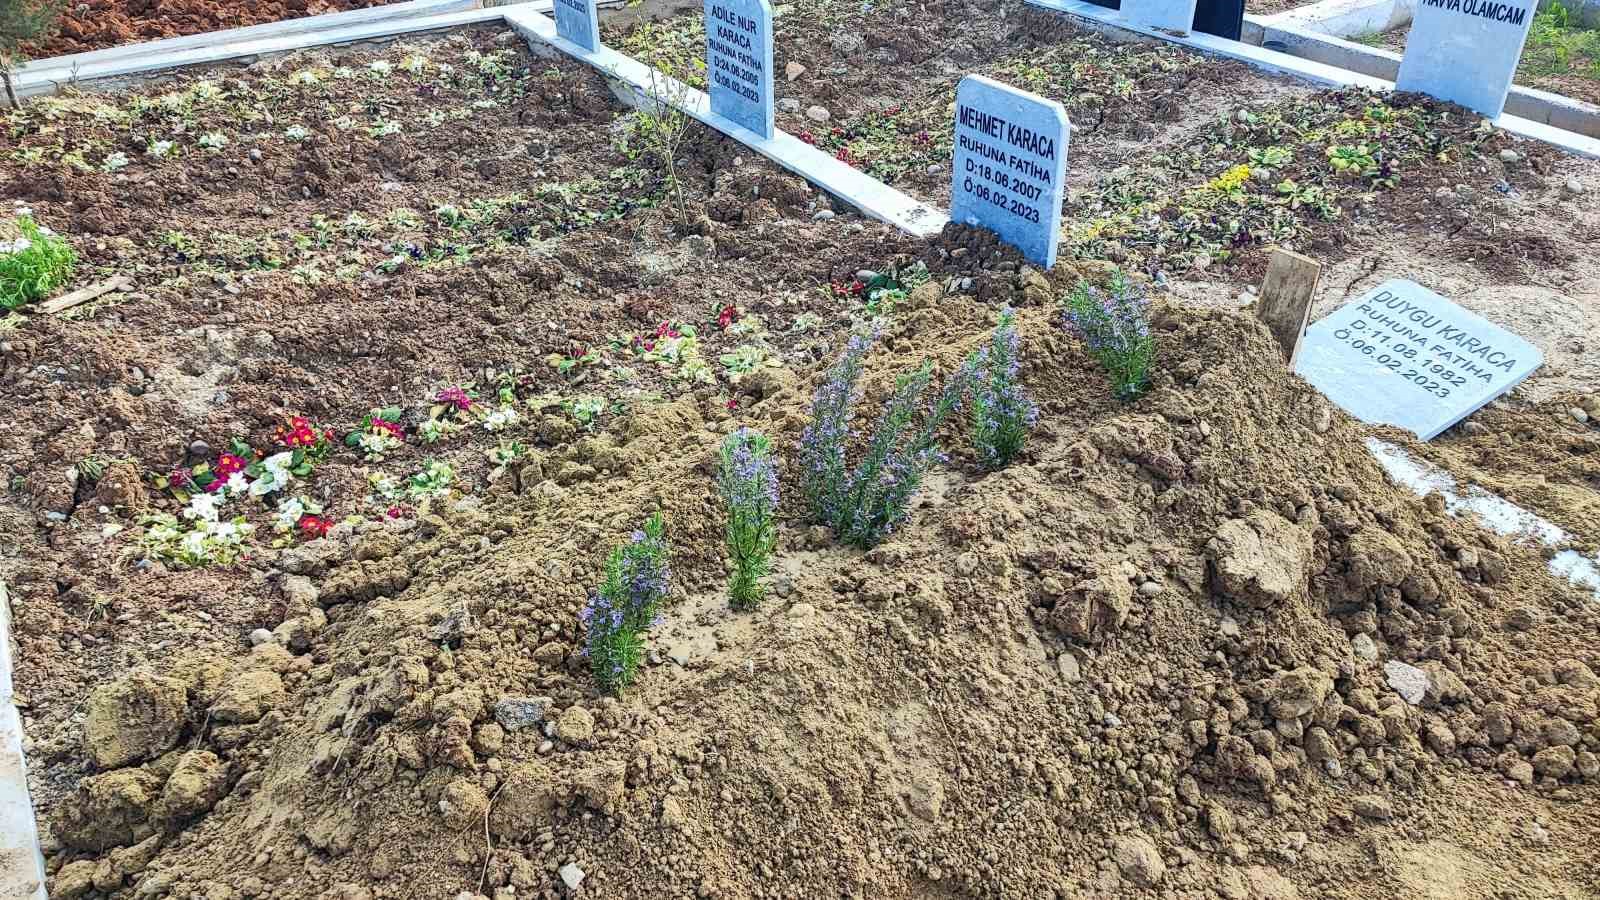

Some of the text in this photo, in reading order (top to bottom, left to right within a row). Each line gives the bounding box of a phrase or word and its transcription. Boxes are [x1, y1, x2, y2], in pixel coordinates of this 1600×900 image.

[738, 15, 757, 36] NUR
[1463, 0, 1526, 25] OLAMCAM
[708, 38, 763, 73] RUHUNA FATİHA
[717, 24, 752, 52] KARACA
[960, 105, 1055, 161] MEHMET KARACA
[960, 134, 1051, 185] RUHUNA FATİHA
[966, 157, 1042, 201] D:18.06.2007
[964, 175, 1040, 224] Ö:06.02.2023
[1355, 303, 1429, 347] RUHUNA
[1373, 290, 1517, 373] DUYGU KARACA
[1334, 327, 1451, 399] Ö:06.02.2023
[1350, 319, 1467, 388] D:11.08.1982
